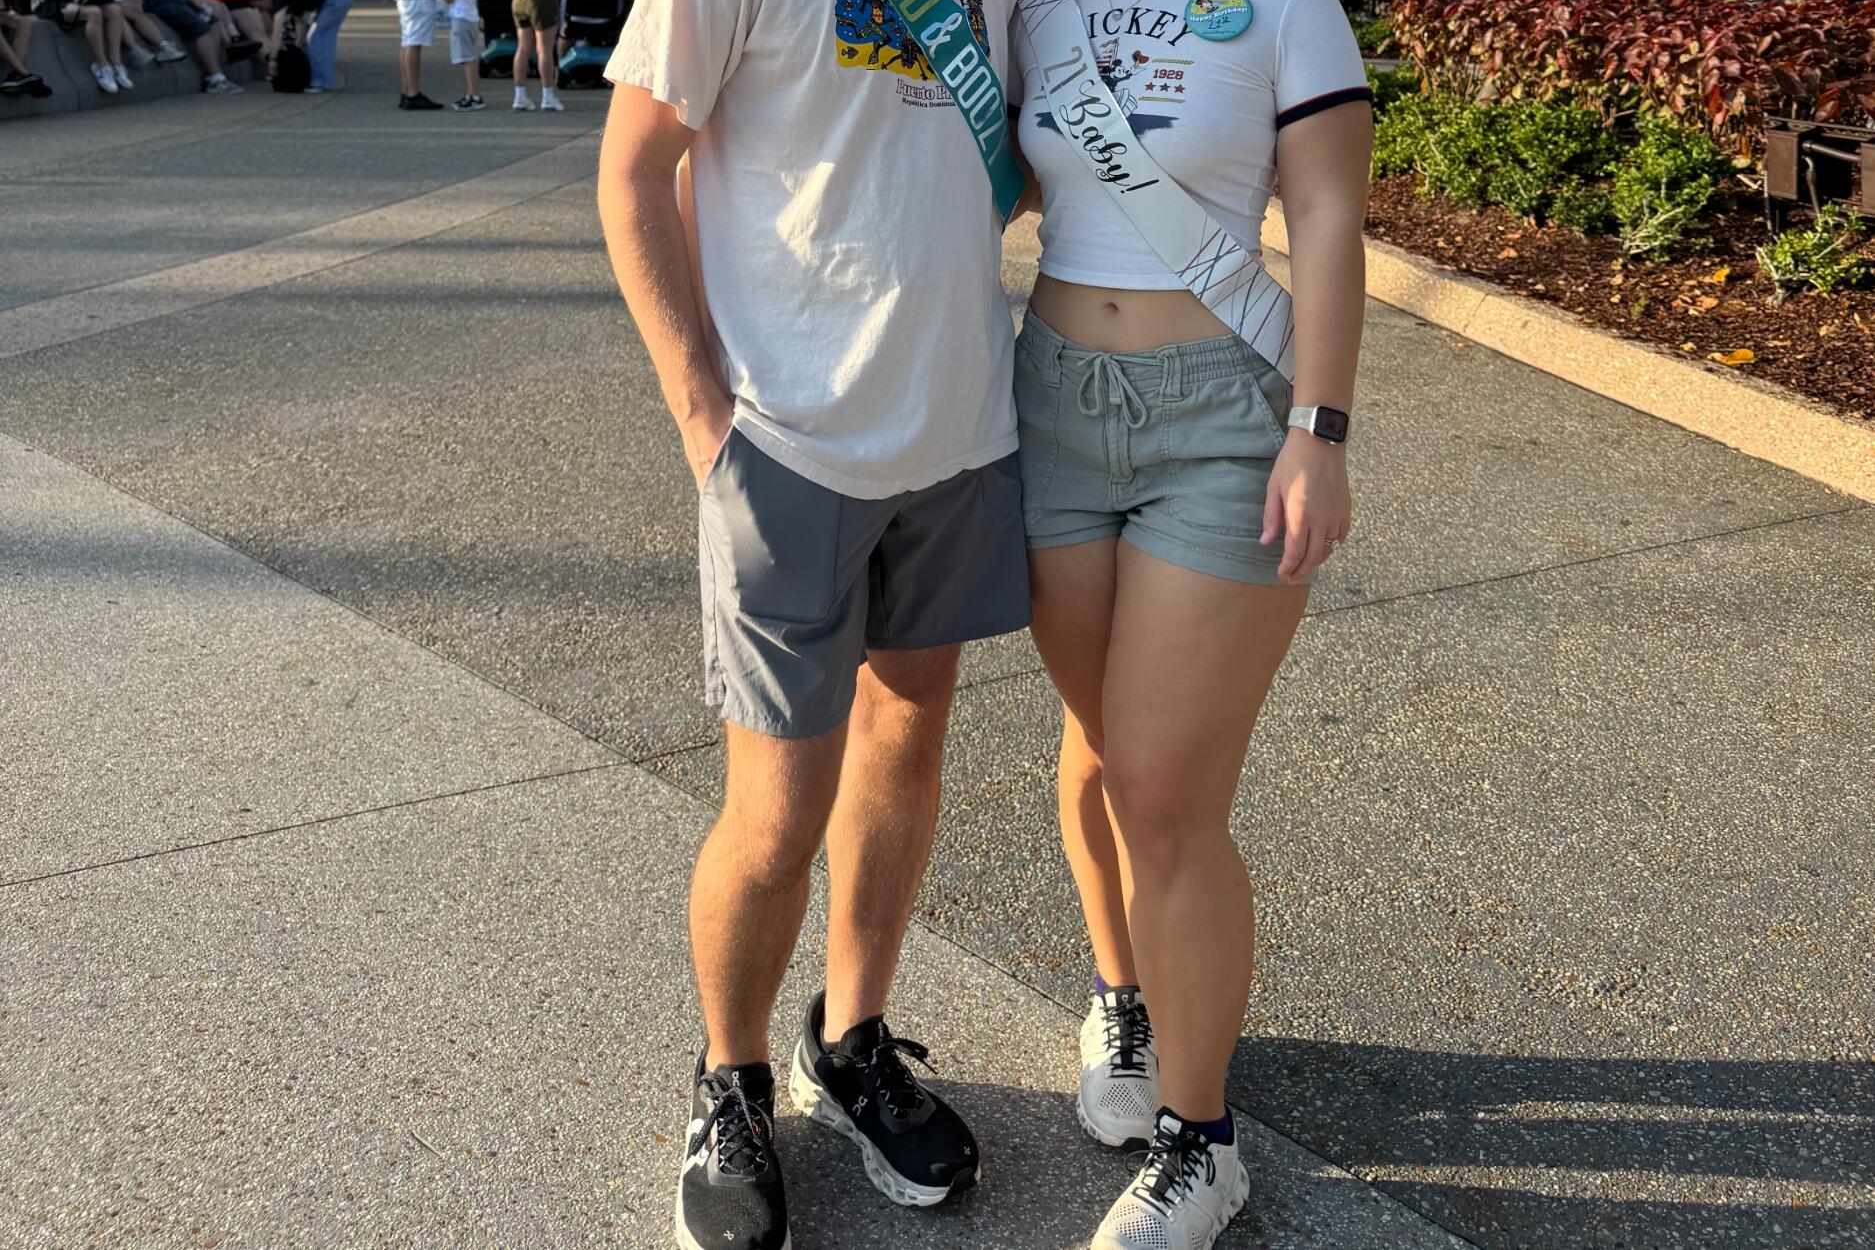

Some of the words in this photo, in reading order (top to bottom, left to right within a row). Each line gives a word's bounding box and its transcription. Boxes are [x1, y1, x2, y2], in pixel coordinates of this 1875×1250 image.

[920, 12, 963, 60] &
[1086, 7, 1193, 46] ICKEY
[895, 78, 936, 101] Puerto
[1043, 46, 1088, 95] 21
[1152, 68, 1184, 80] 1928
[1058, 79, 1160, 194] Baby!
